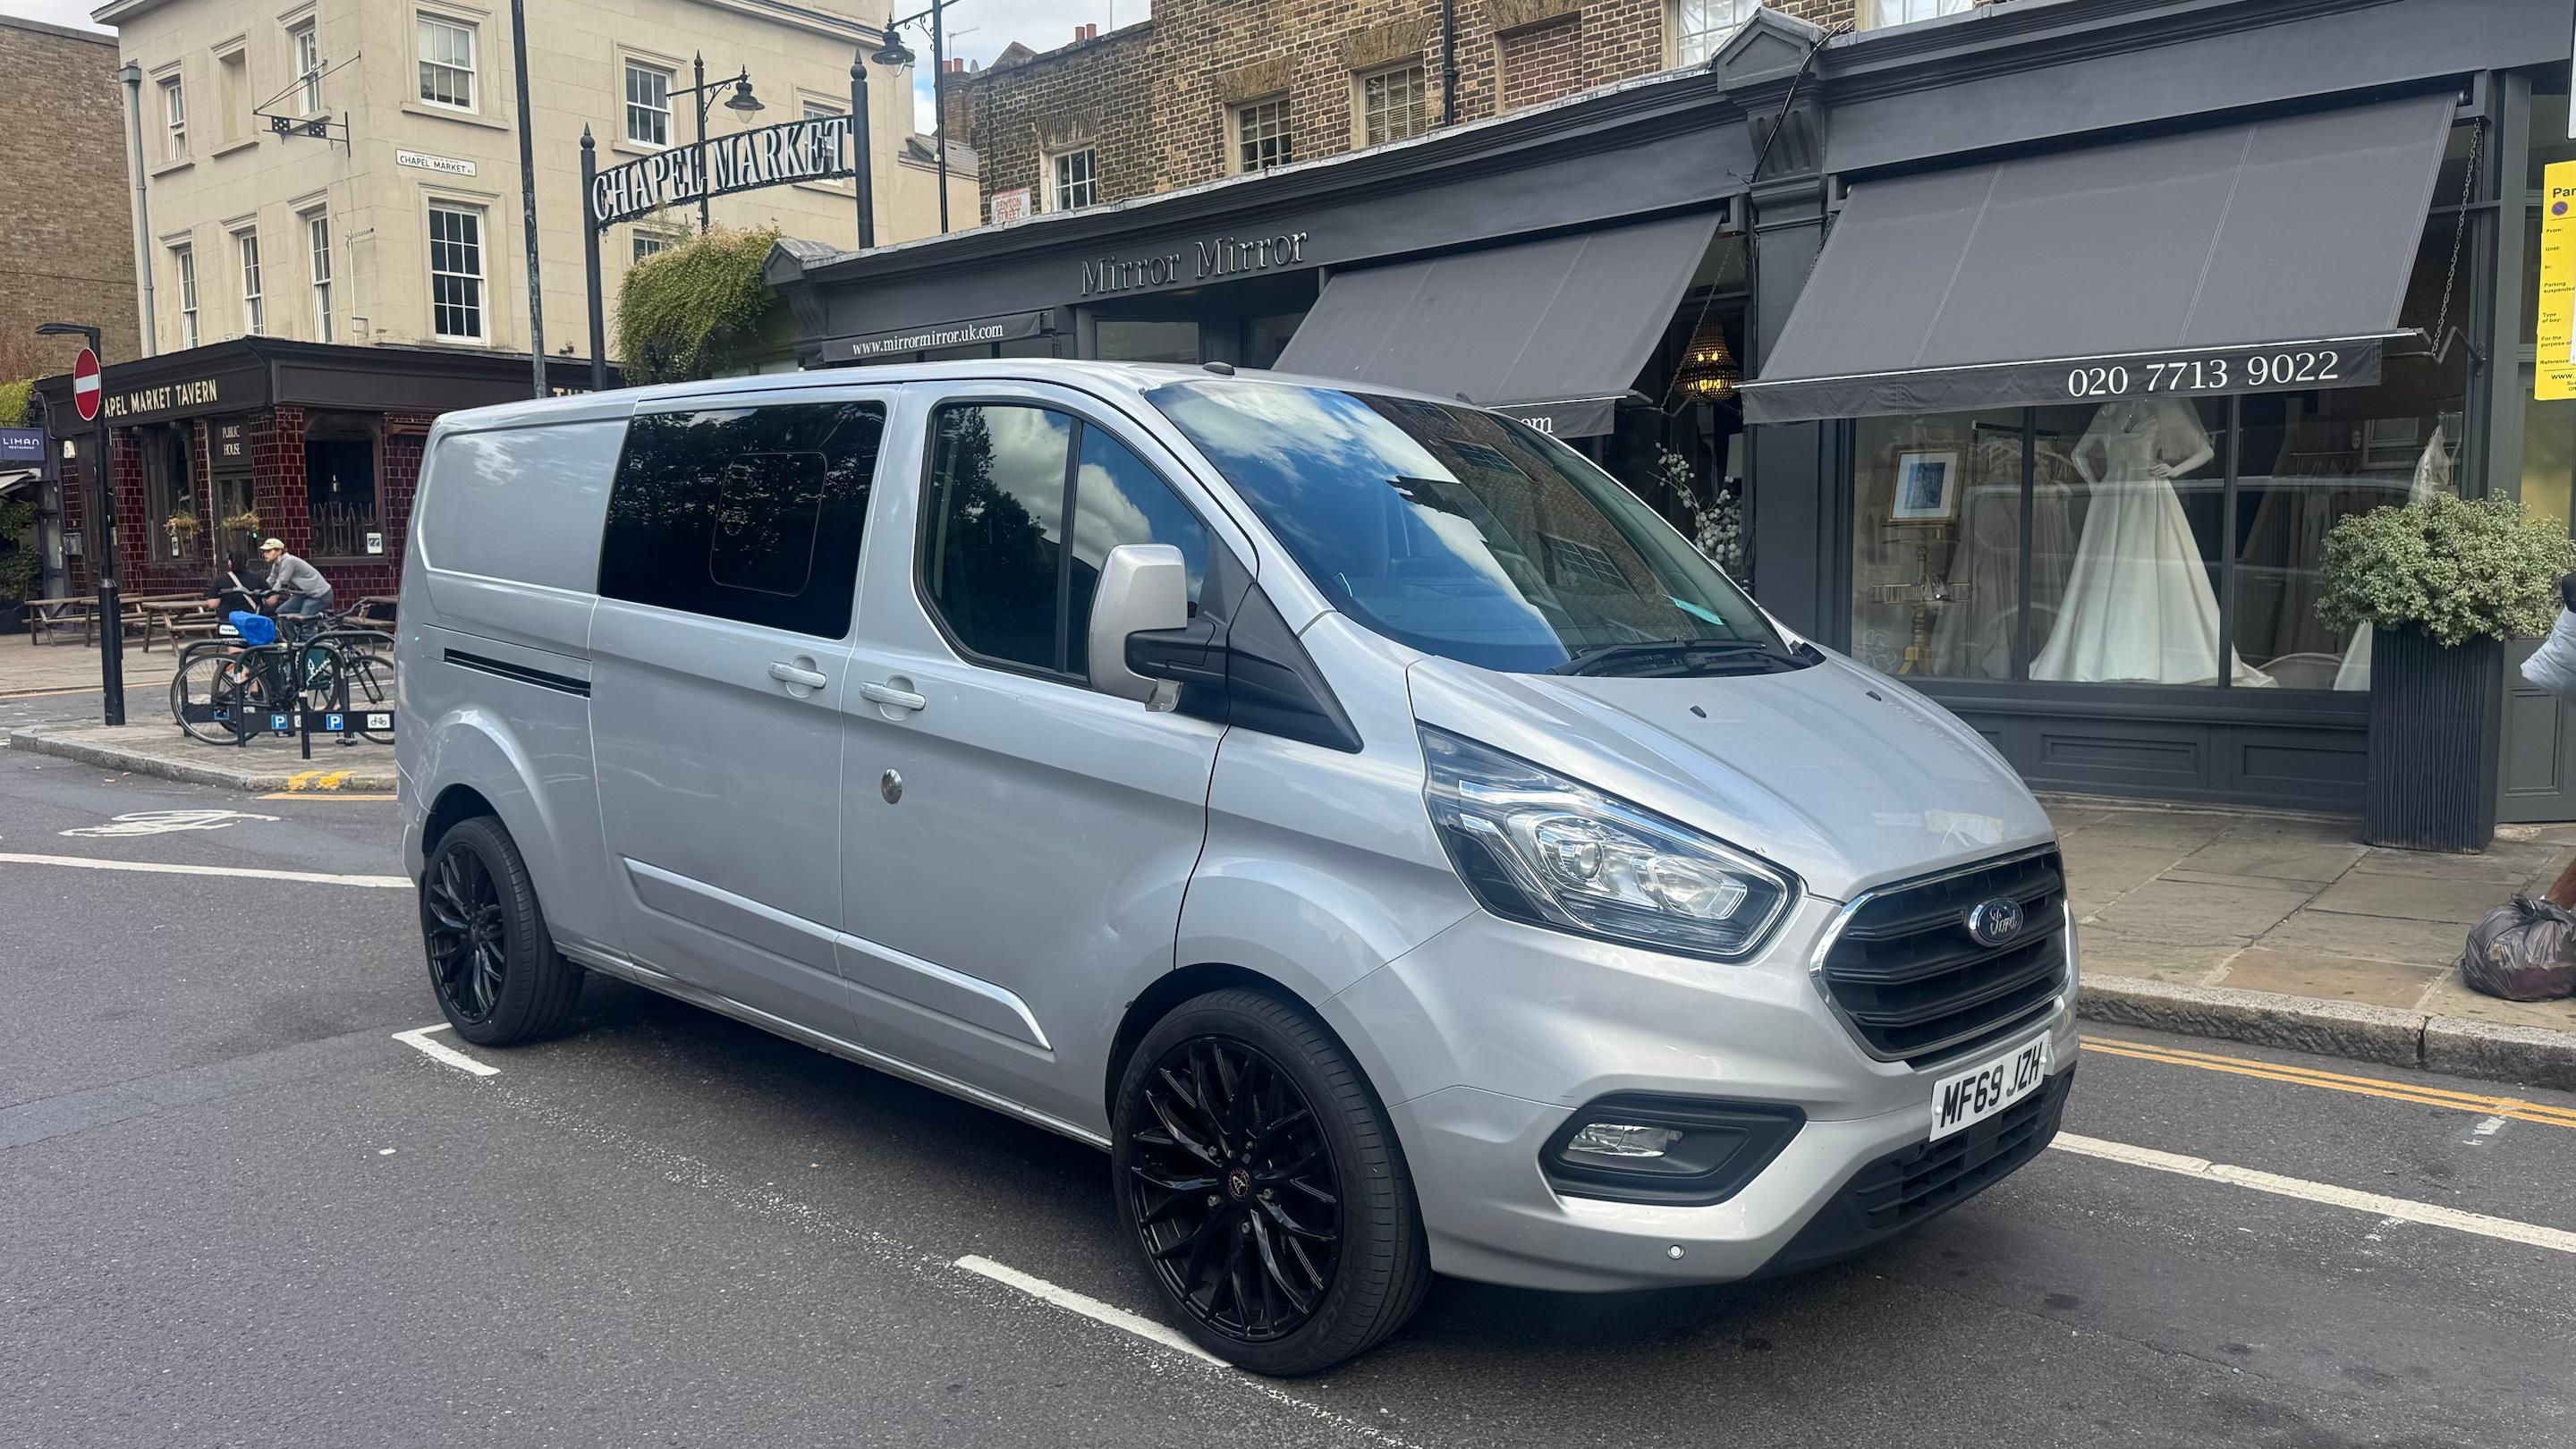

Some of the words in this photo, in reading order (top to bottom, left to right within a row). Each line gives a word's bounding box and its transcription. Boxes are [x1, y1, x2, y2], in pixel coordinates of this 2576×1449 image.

[400, 155, 429, 167] CHAPEL
[434, 161, 465, 173] MARKET
[592, 144, 706, 221] CHAPEL
[712, 117, 853, 191] MARKET
[995, 208, 1020, 222] STREET
[1080, 253, 1182, 297] Mirror
[1194, 231, 1309, 280] Mirror
[852, 324, 1004, 356] www.mirrormirror.uk.com
[2067, 366, 2129, 397] 020
[2147, 359, 2229, 392] 7713
[2246, 351, 2339, 386] 9022
[130, 386, 171, 413] MARKET
[175, 378, 217, 406] TAVERN
[3, 437, 40, 445] LIMAN
[222, 425, 241, 438] PUBLIC
[223, 443, 242, 456] HOUSE
[1988, 906, 2019, 936] Ford
[1939, 1063, 2004, 1129] MF69
[2006, 1041, 2043, 1097] JZH
